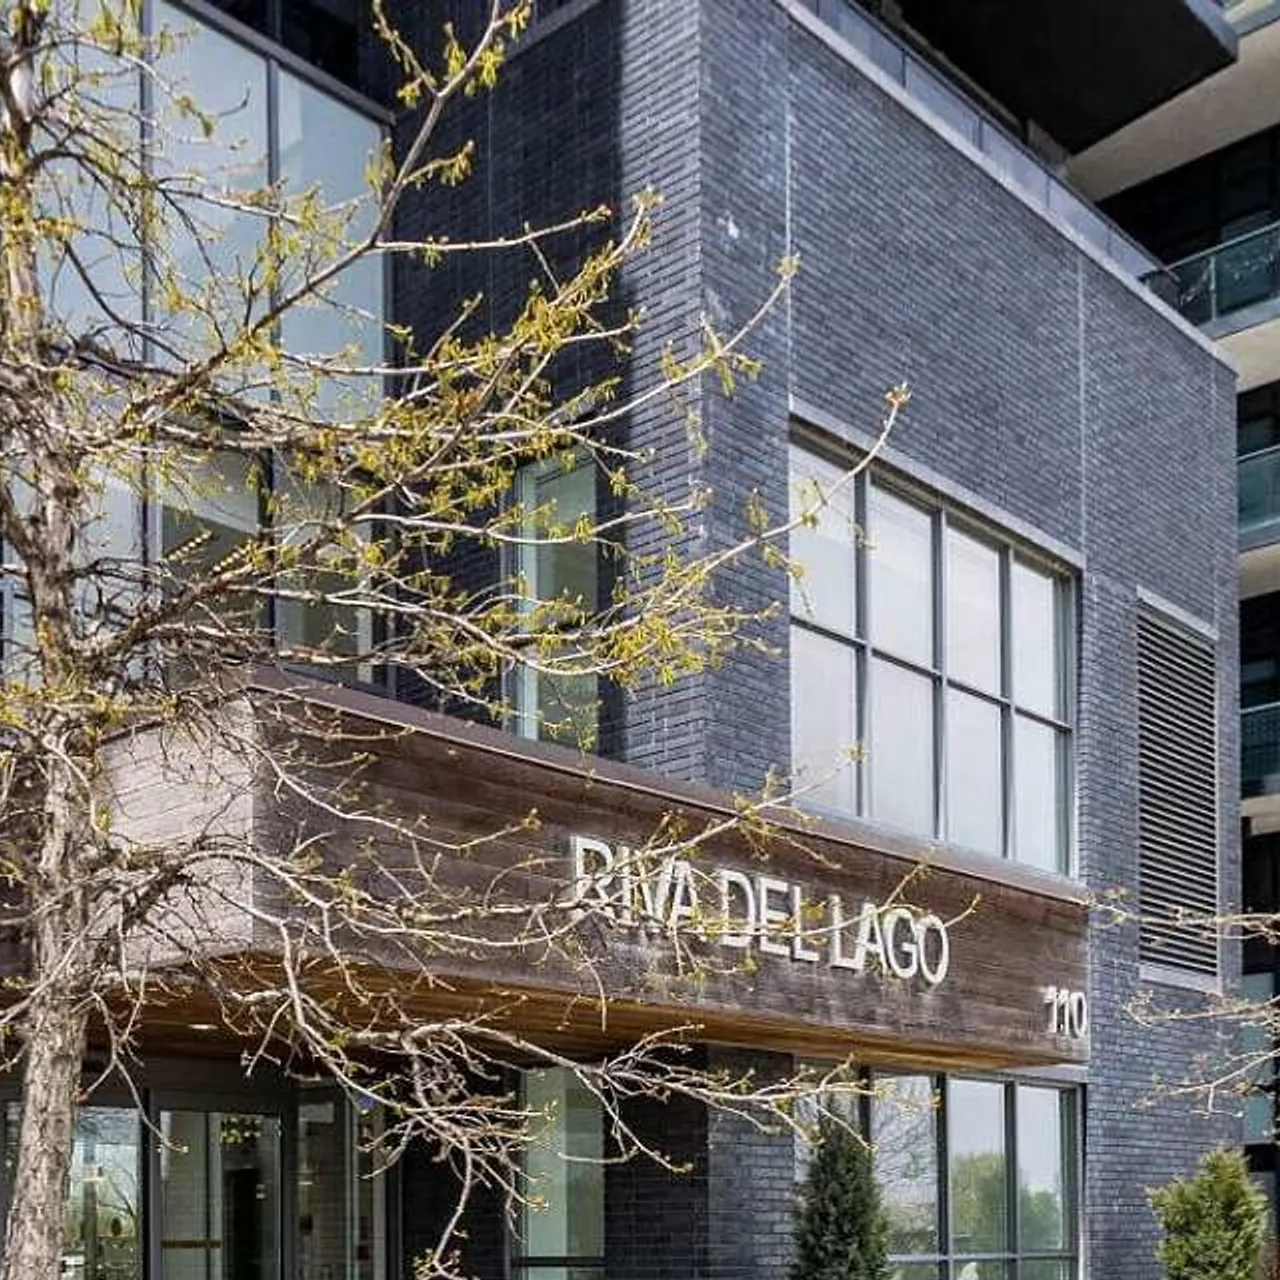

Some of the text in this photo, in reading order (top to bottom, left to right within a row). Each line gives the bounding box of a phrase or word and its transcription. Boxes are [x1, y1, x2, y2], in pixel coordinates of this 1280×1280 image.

[570, 835, 949, 985] RIVA DEL LAGO
[1041, 986, 1088, 1037] 110
